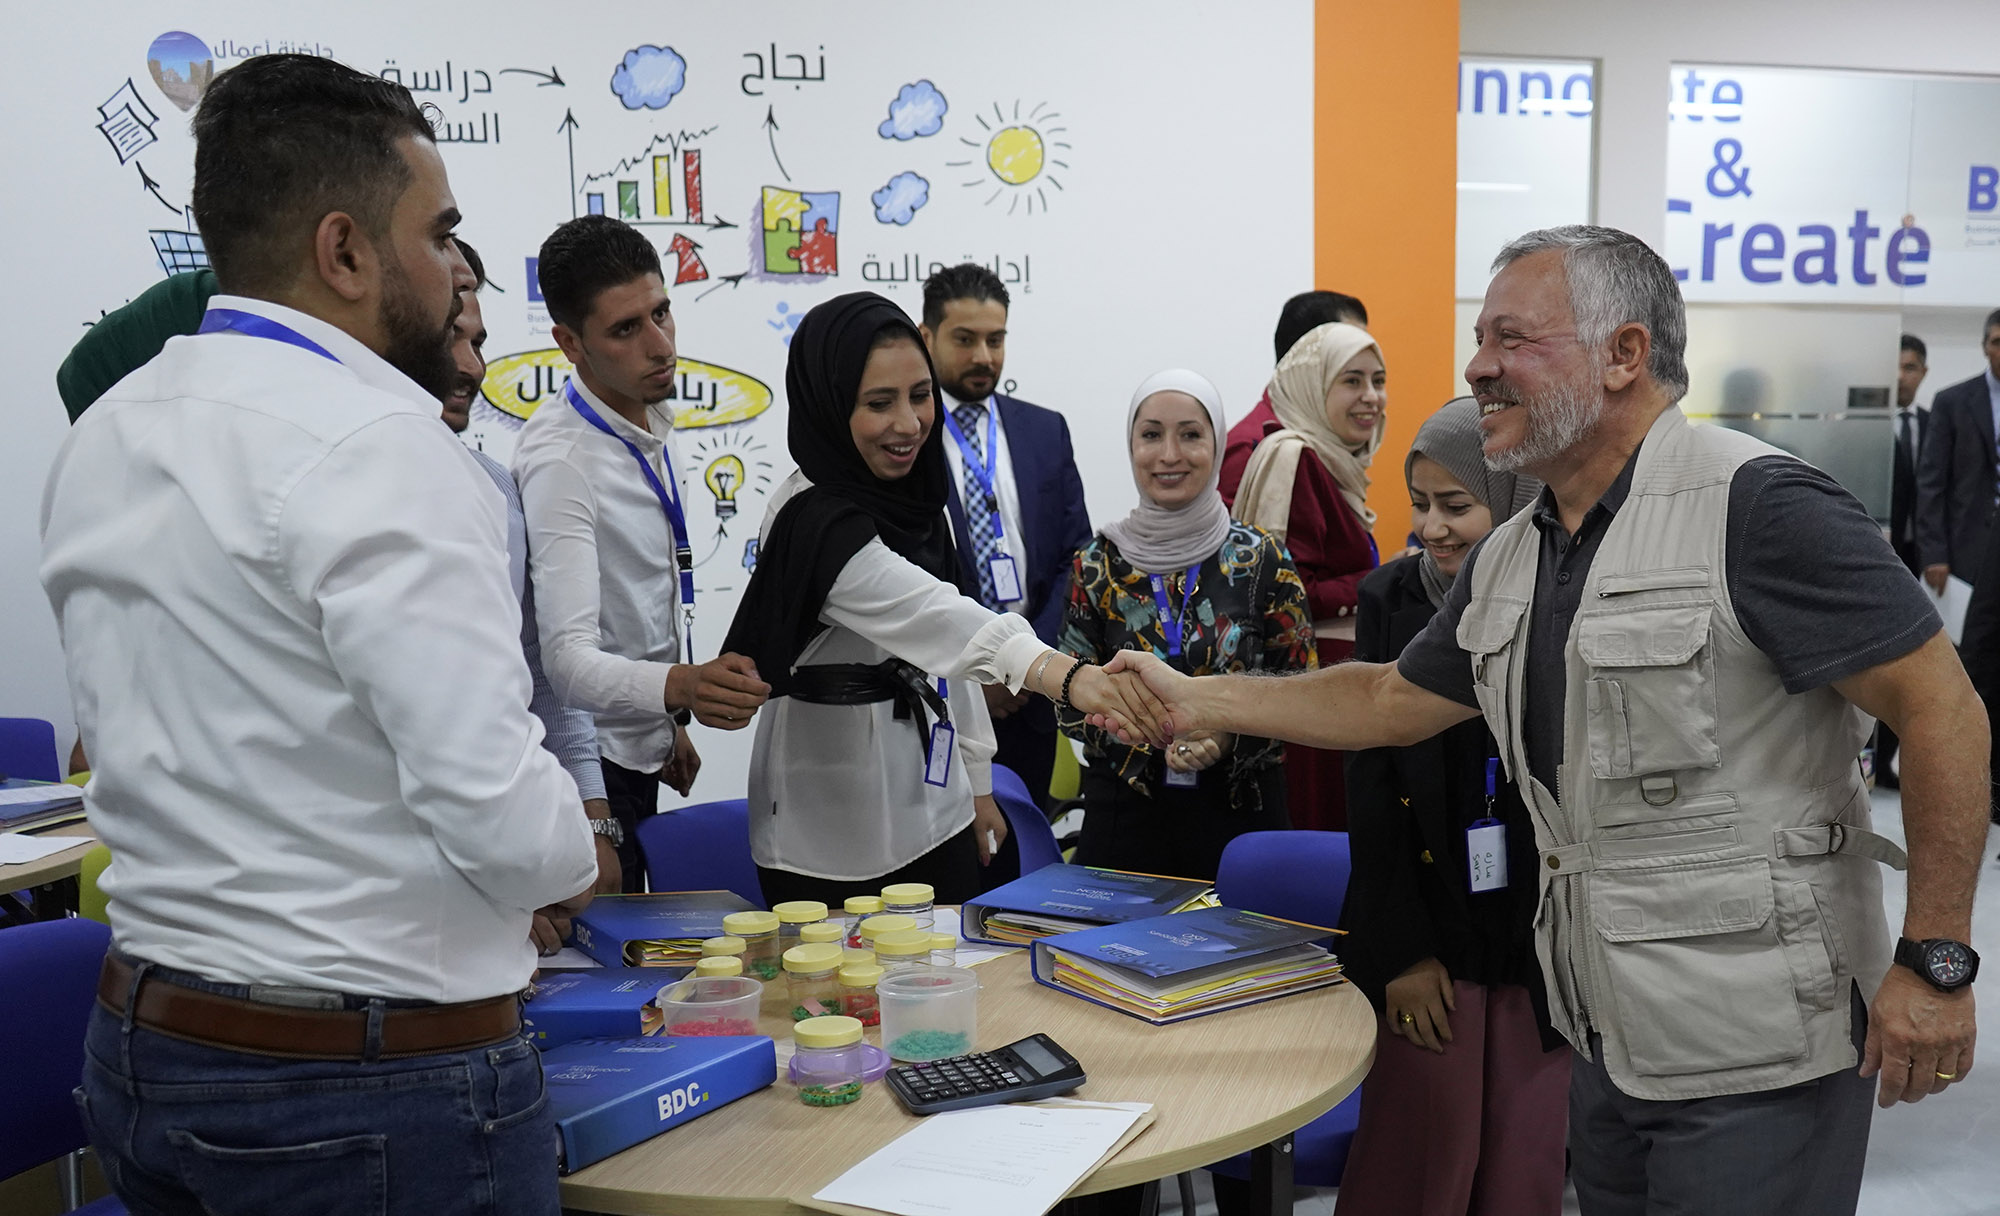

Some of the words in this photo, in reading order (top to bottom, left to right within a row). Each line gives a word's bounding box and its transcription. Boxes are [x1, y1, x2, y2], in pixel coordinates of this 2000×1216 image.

[214, 39, 270, 59] أعمال
[741, 42, 825, 96] نجاح
[380, 59, 493, 103] دراسة
[432, 112, 500, 144] الس
[1706, 137, 1752, 198] &
